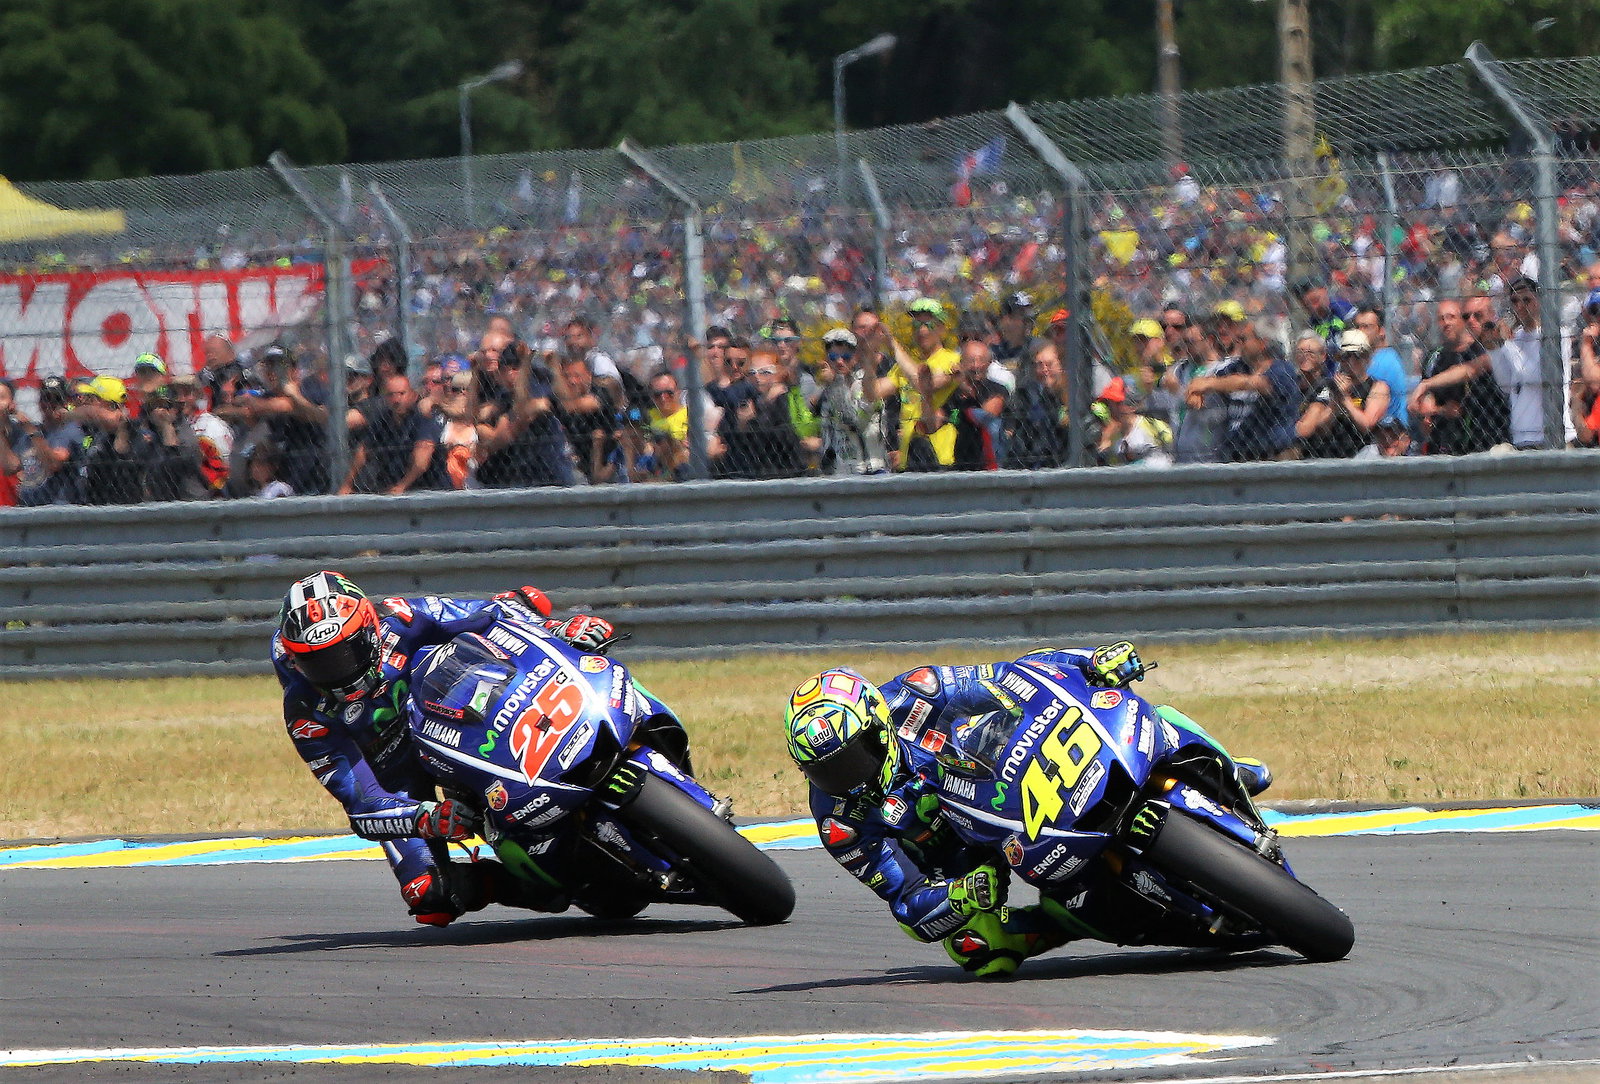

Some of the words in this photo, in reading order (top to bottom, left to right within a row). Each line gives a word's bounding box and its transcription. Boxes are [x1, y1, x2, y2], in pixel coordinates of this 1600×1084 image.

[309, 624, 338, 640] Arai
[486, 626, 529, 657] YAMAHA
[494, 657, 557, 731] movistar
[1000, 671, 1039, 703] YAMAHA
[509, 668, 585, 787] 25
[904, 700, 926, 730] YAMAHA
[421, 719, 462, 748] YAMAHA
[812, 727, 831, 744] agv
[1001, 698, 1064, 782] movistar
[943, 773, 976, 801] YAMAHA
[1020, 706, 1102, 842] 46
[512, 792, 551, 821] ENEOS
[890, 802, 905, 822] agv
[1033, 843, 1067, 875] ENEOS
